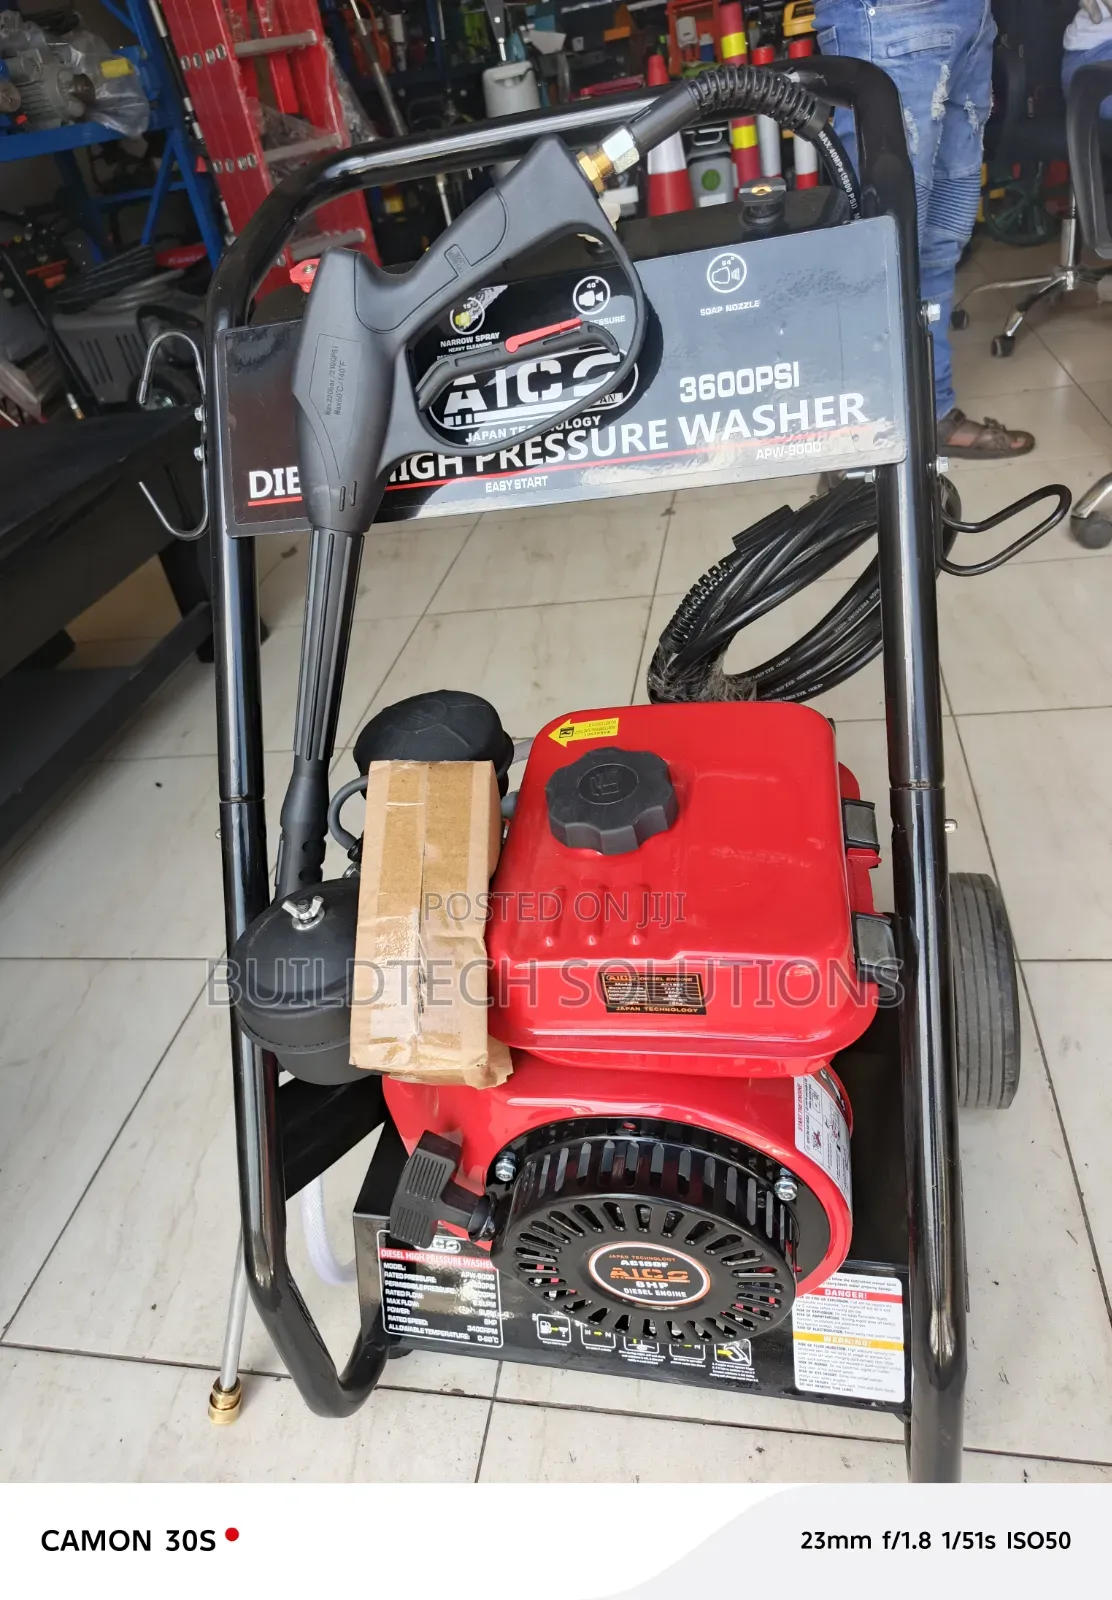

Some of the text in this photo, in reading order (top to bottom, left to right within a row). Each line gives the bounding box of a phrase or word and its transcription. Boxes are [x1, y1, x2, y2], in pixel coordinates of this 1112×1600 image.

[840, 172, 852, 193] (5800
[700, 300, 760, 316] SOAP NOZZLE
[590, 316, 626, 326] ESSURE
[440, 332, 500, 348] NARROW SPRAY
[680, 362, 800, 402] 3600PSI
[465, 415, 602, 443] JAPAN TEOLOGY
[249, 392, 869, 498] DIE IGH PRESSURE WASHER
[756, 442, 822, 460] APW-9000
[486, 476, 548, 494] EASY START
[380, 1250, 404, 1259] DIESEL
[406, 1252, 425, 1261] HIGH
[427, 1255, 462, 1266] PRESSURE
[384, 1262, 406, 1271] MODEL:
[385, 1288, 405, 1297] RATED
[624, 1288, 654, 1296] DIESEL
[824, 1288, 868, 1300] DANGER!
[386, 1298, 401, 1306] MAX
[388, 1316, 408, 1324] RATED
[824, 1336, 872, 1346] WARNING!
